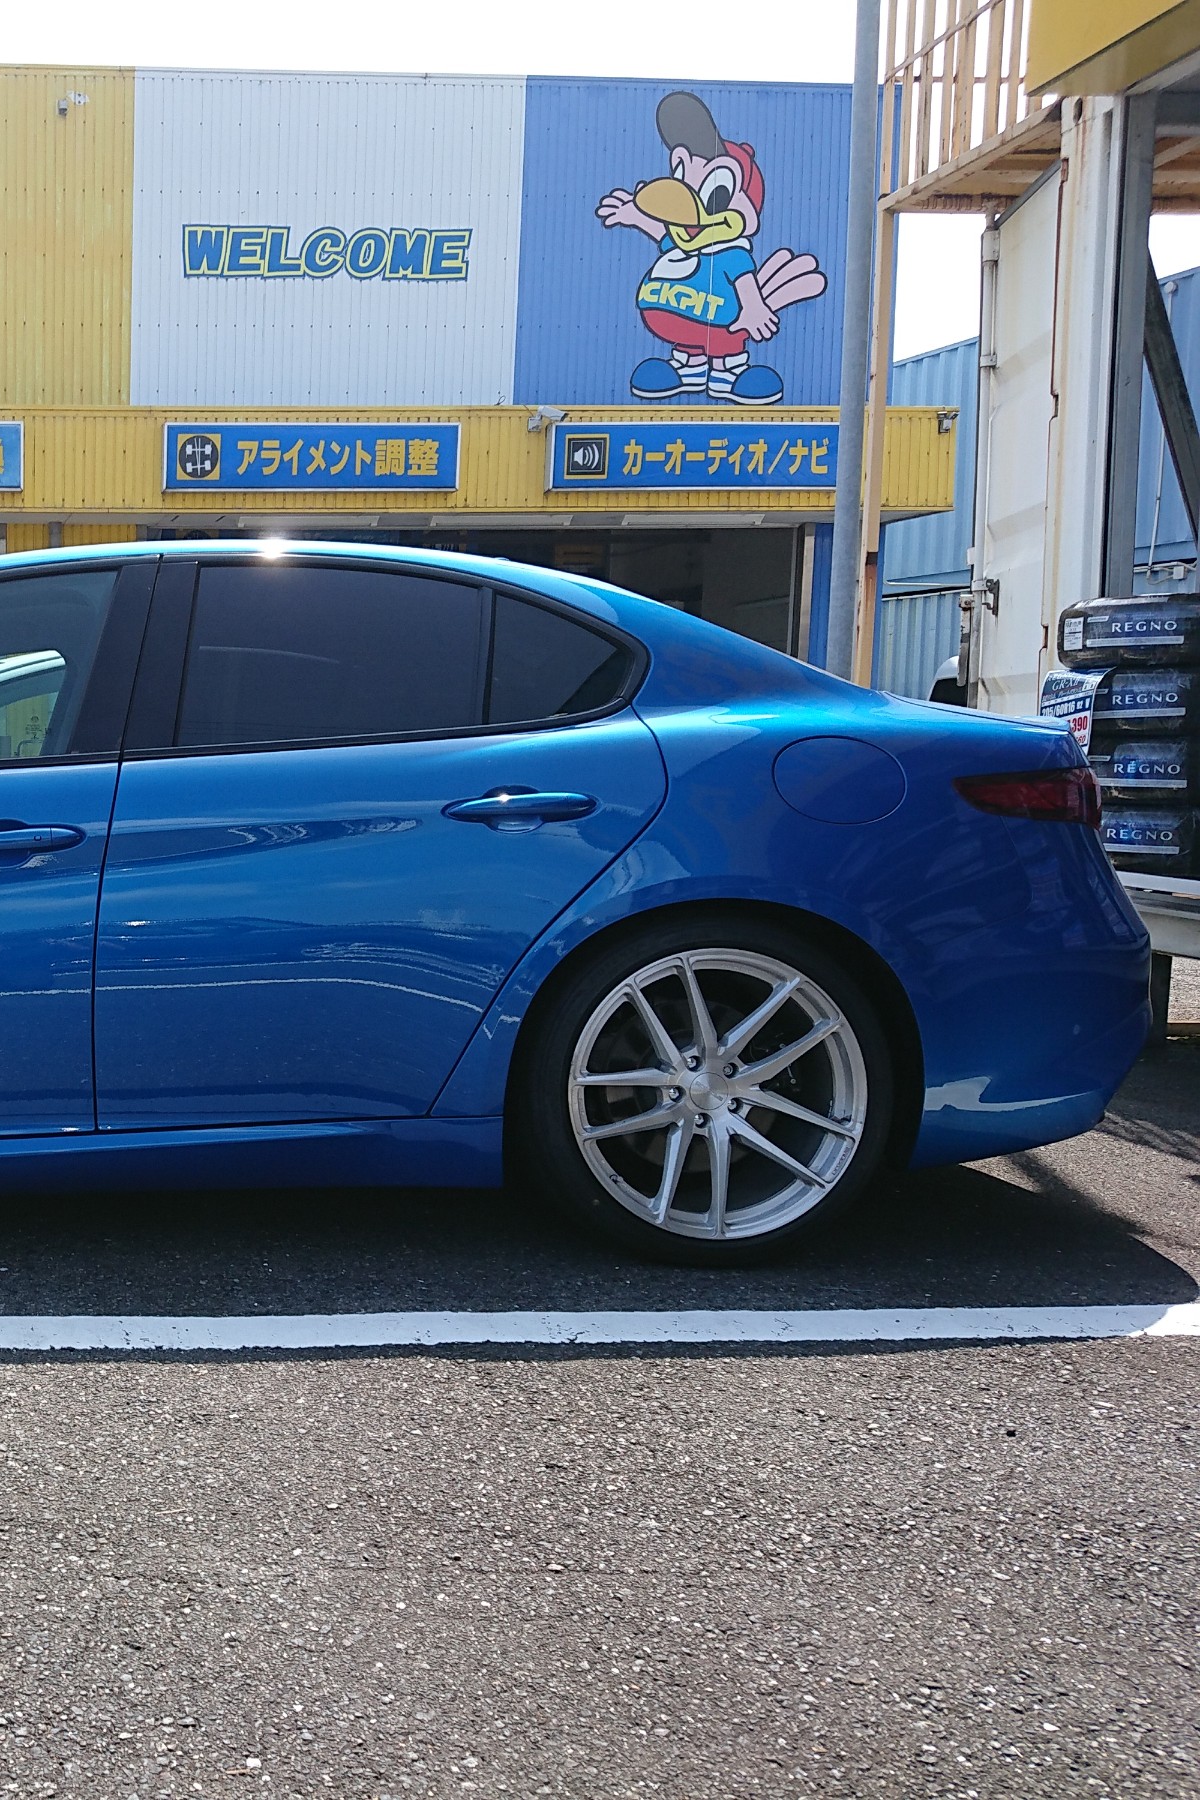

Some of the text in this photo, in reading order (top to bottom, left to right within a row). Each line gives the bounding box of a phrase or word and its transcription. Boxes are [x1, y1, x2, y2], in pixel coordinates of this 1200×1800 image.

[182, 224, 473, 281] WELCOME
[236, 438, 440, 477] アライメント調整
[622, 437, 830, 476] カーオーディオ/ナビ
[1111, 620, 1178, 633] REGNO
[1112, 692, 1179, 705] REGNO
[1041, 701, 1076, 717] 205/60R16
[1068, 715, 1088, 733] 390
[1113, 763, 1181, 775] REGNO
[1106, 828, 1173, 841] REGNO
